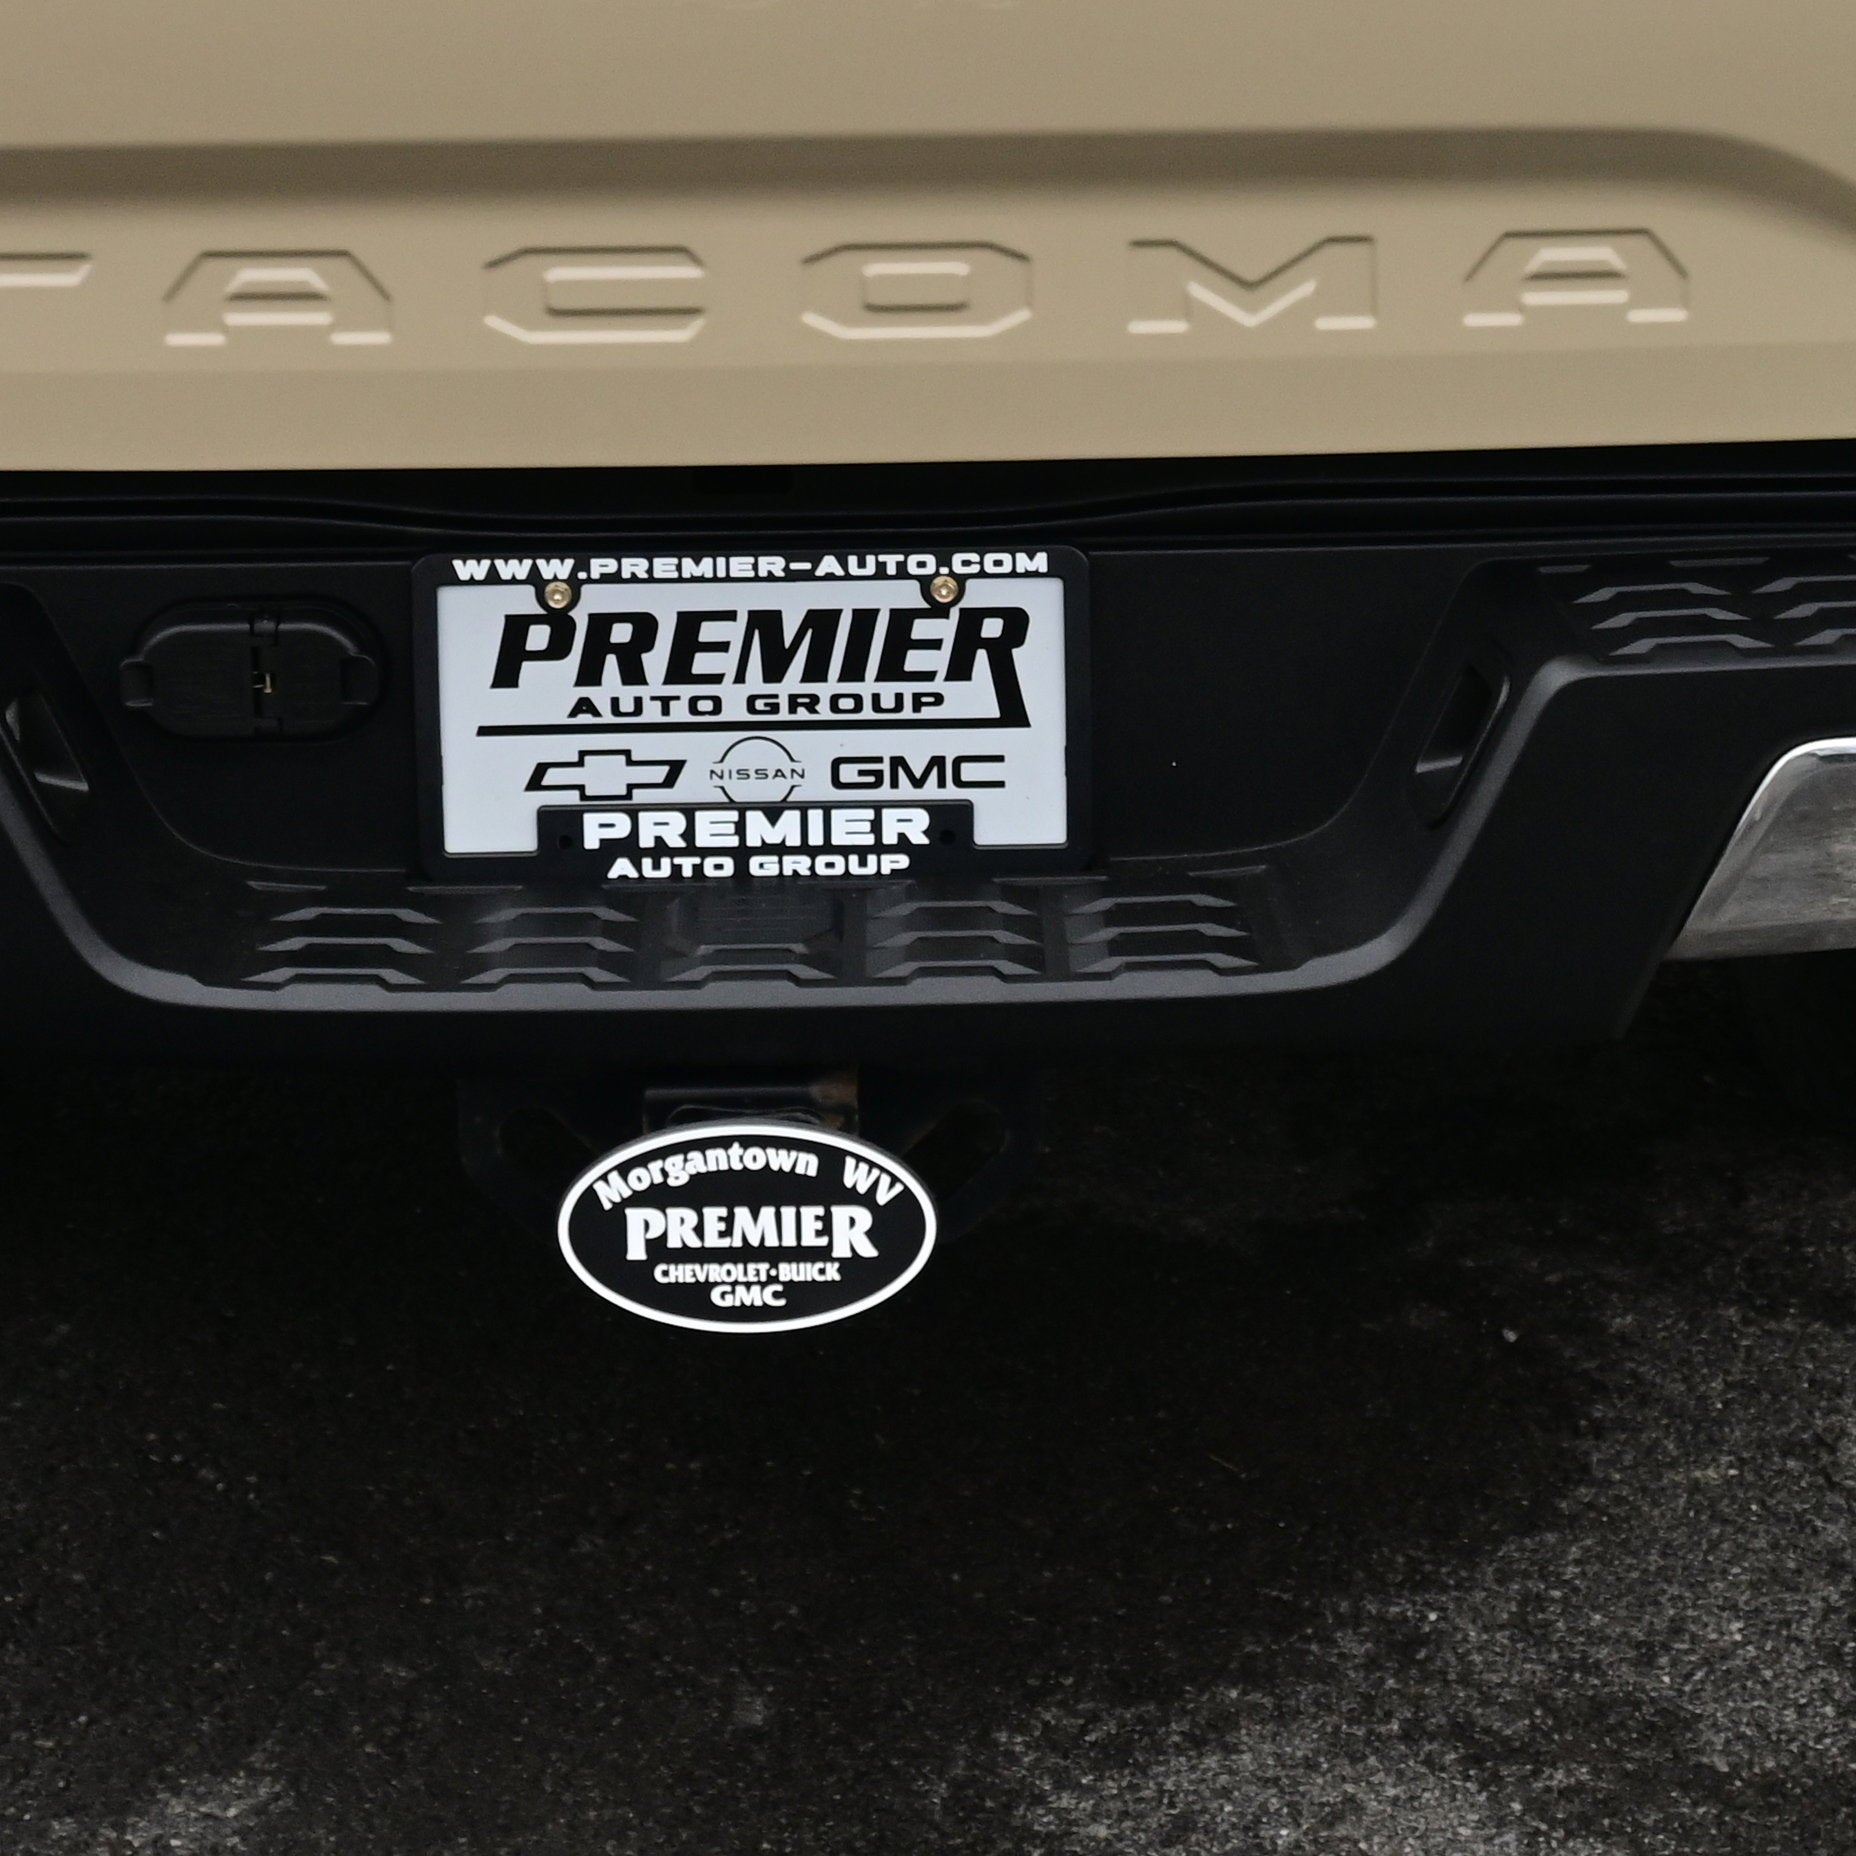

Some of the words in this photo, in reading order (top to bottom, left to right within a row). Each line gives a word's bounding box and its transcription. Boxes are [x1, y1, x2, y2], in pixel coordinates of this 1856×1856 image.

[452, 552, 1048, 581] WWW.PREMIER-AUTO.COM
[490, 606, 1032, 728] PREMIER
[567, 695, 723, 718] AUTO
[746, 692, 945, 716] GROUP
[708, 767, 806, 781] NISSAN
[830, 754, 1005, 790] GMC
[582, 808, 931, 850] PREMIER
[606, 855, 734, 879] AUTO
[748, 853, 911, 877] GROUP
[592, 1141, 820, 1211] Morgantown
[842, 1155, 906, 1207] WV
[624, 1204, 880, 1261] PREMIER
[709, 1283, 787, 1308] GMC
